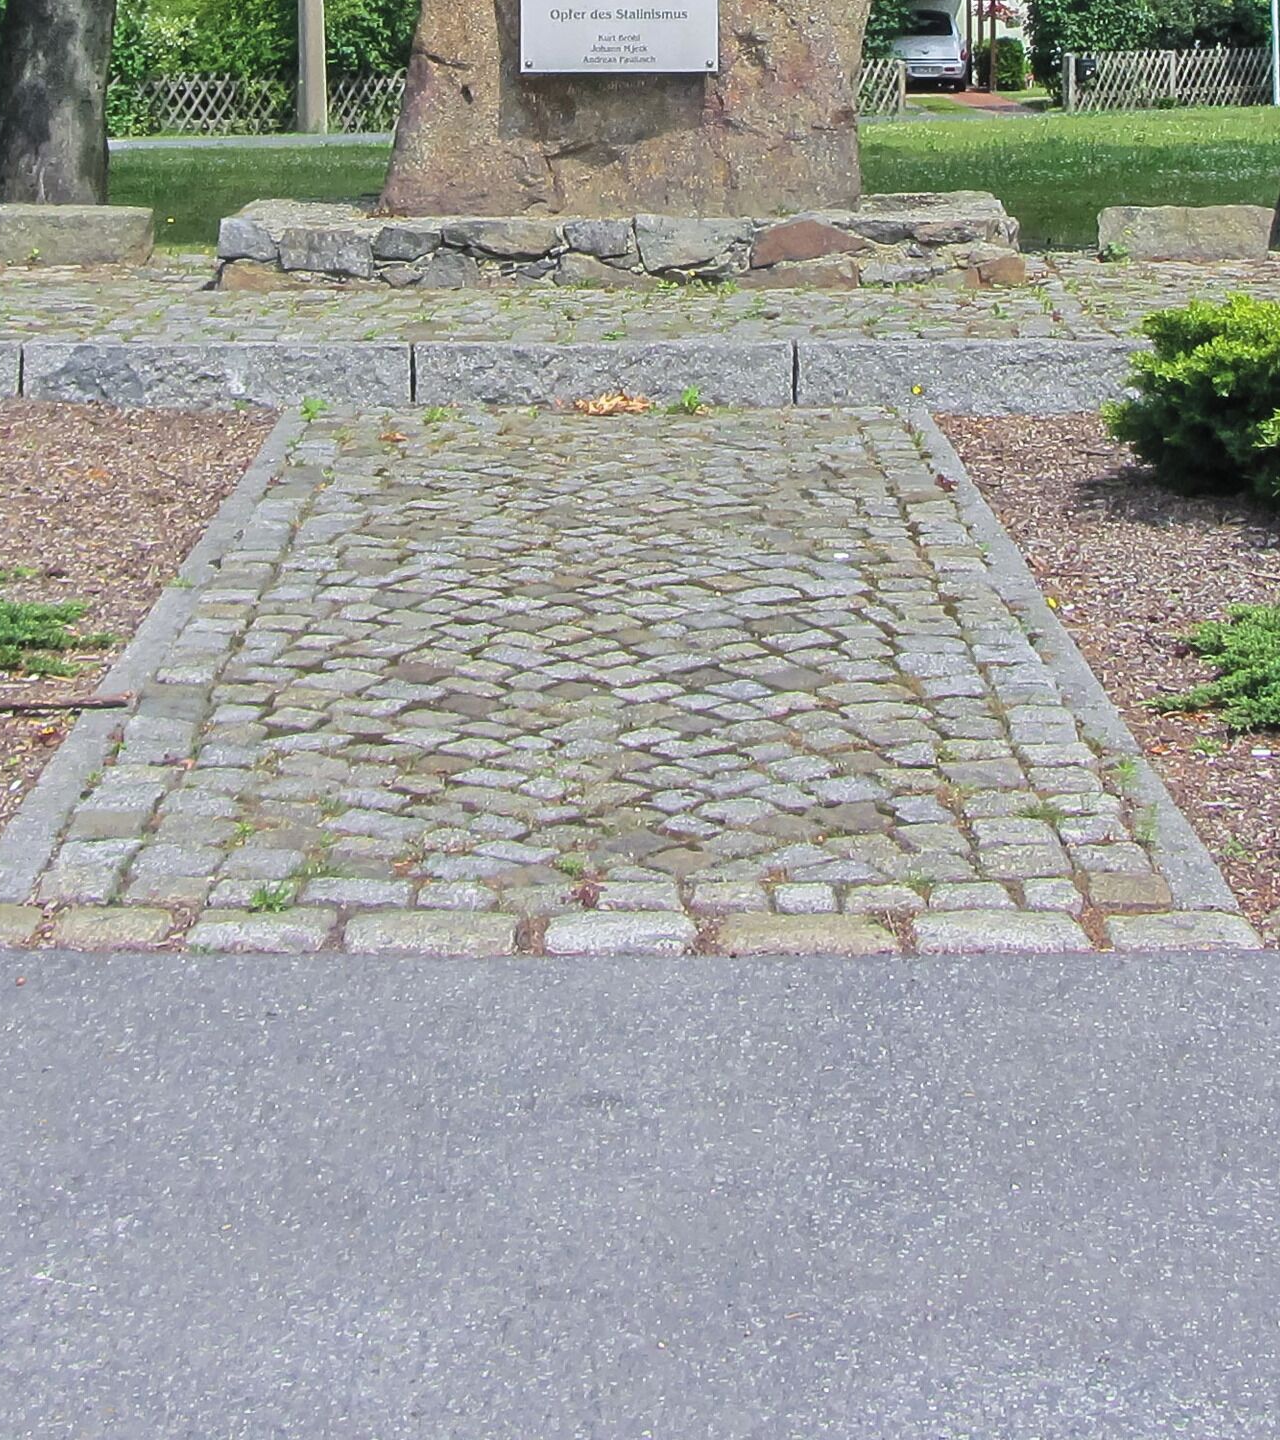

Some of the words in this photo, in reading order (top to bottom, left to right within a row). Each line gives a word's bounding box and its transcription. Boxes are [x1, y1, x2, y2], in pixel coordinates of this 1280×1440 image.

[550, 9, 586, 22] Opfer
[590, 8, 612, 20] des
[615, 8, 688, 20] Stalinismus
